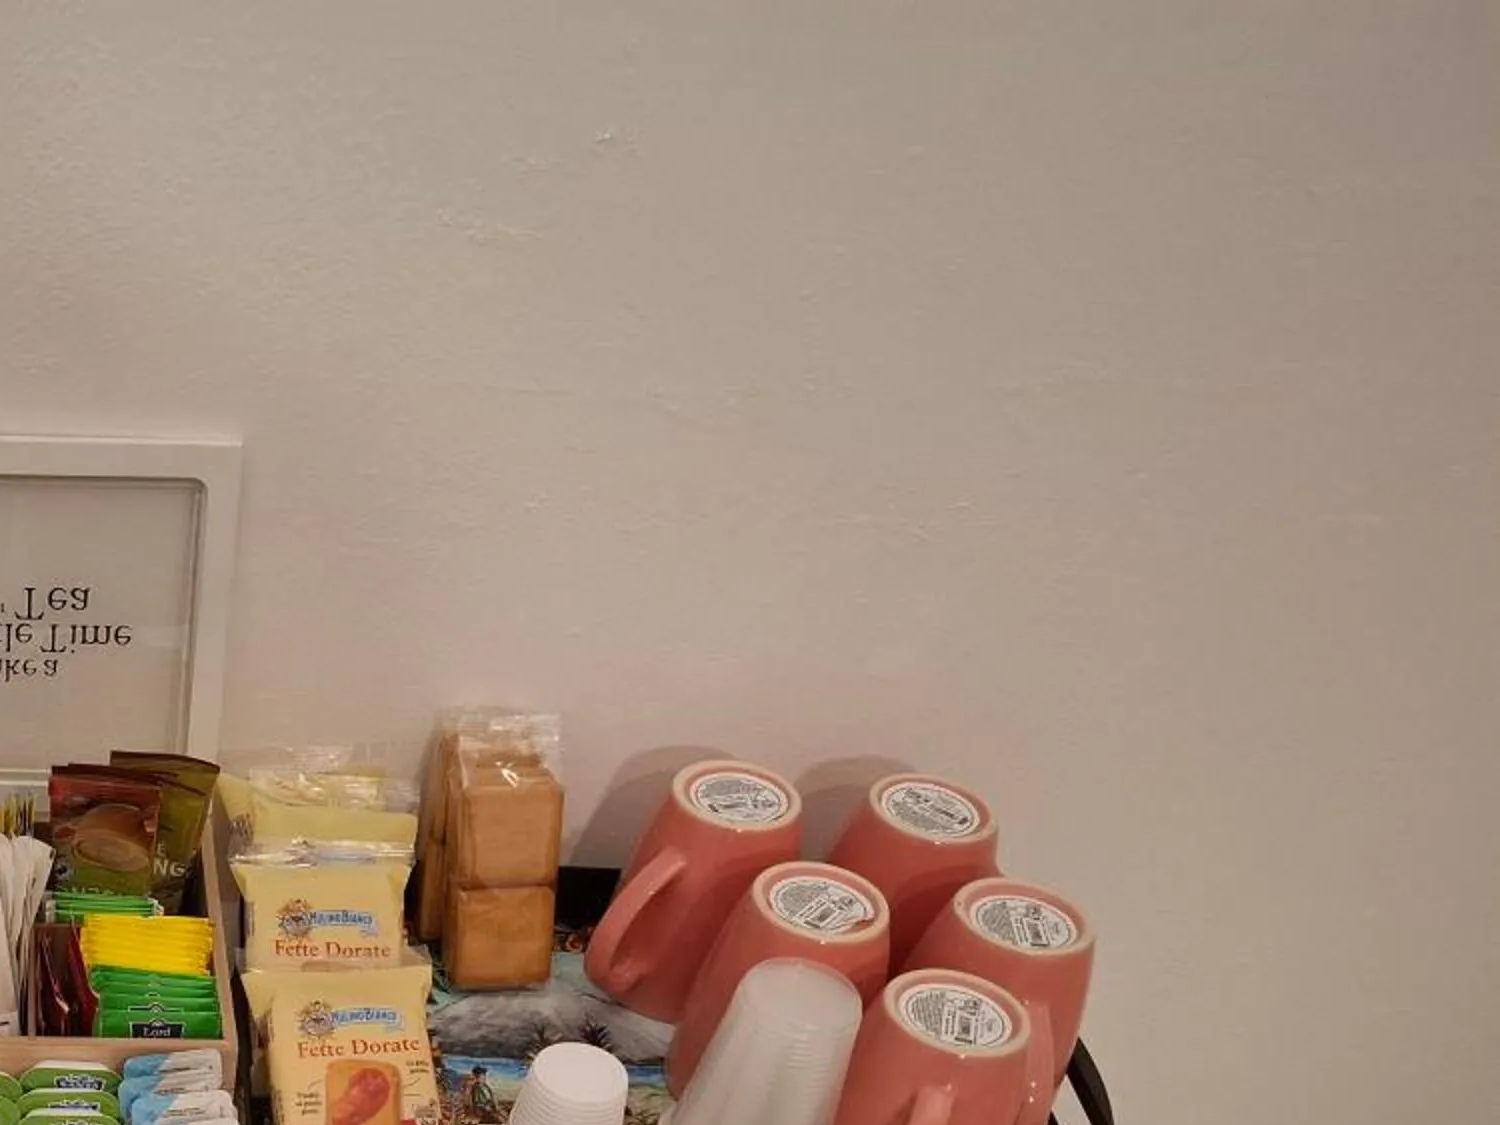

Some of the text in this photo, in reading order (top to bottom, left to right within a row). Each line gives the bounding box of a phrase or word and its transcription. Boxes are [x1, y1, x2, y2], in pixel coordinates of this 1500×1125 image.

[275, 939, 391, 958] Fette Dorate
[297, 1039, 420, 1058] Fette Dorate
